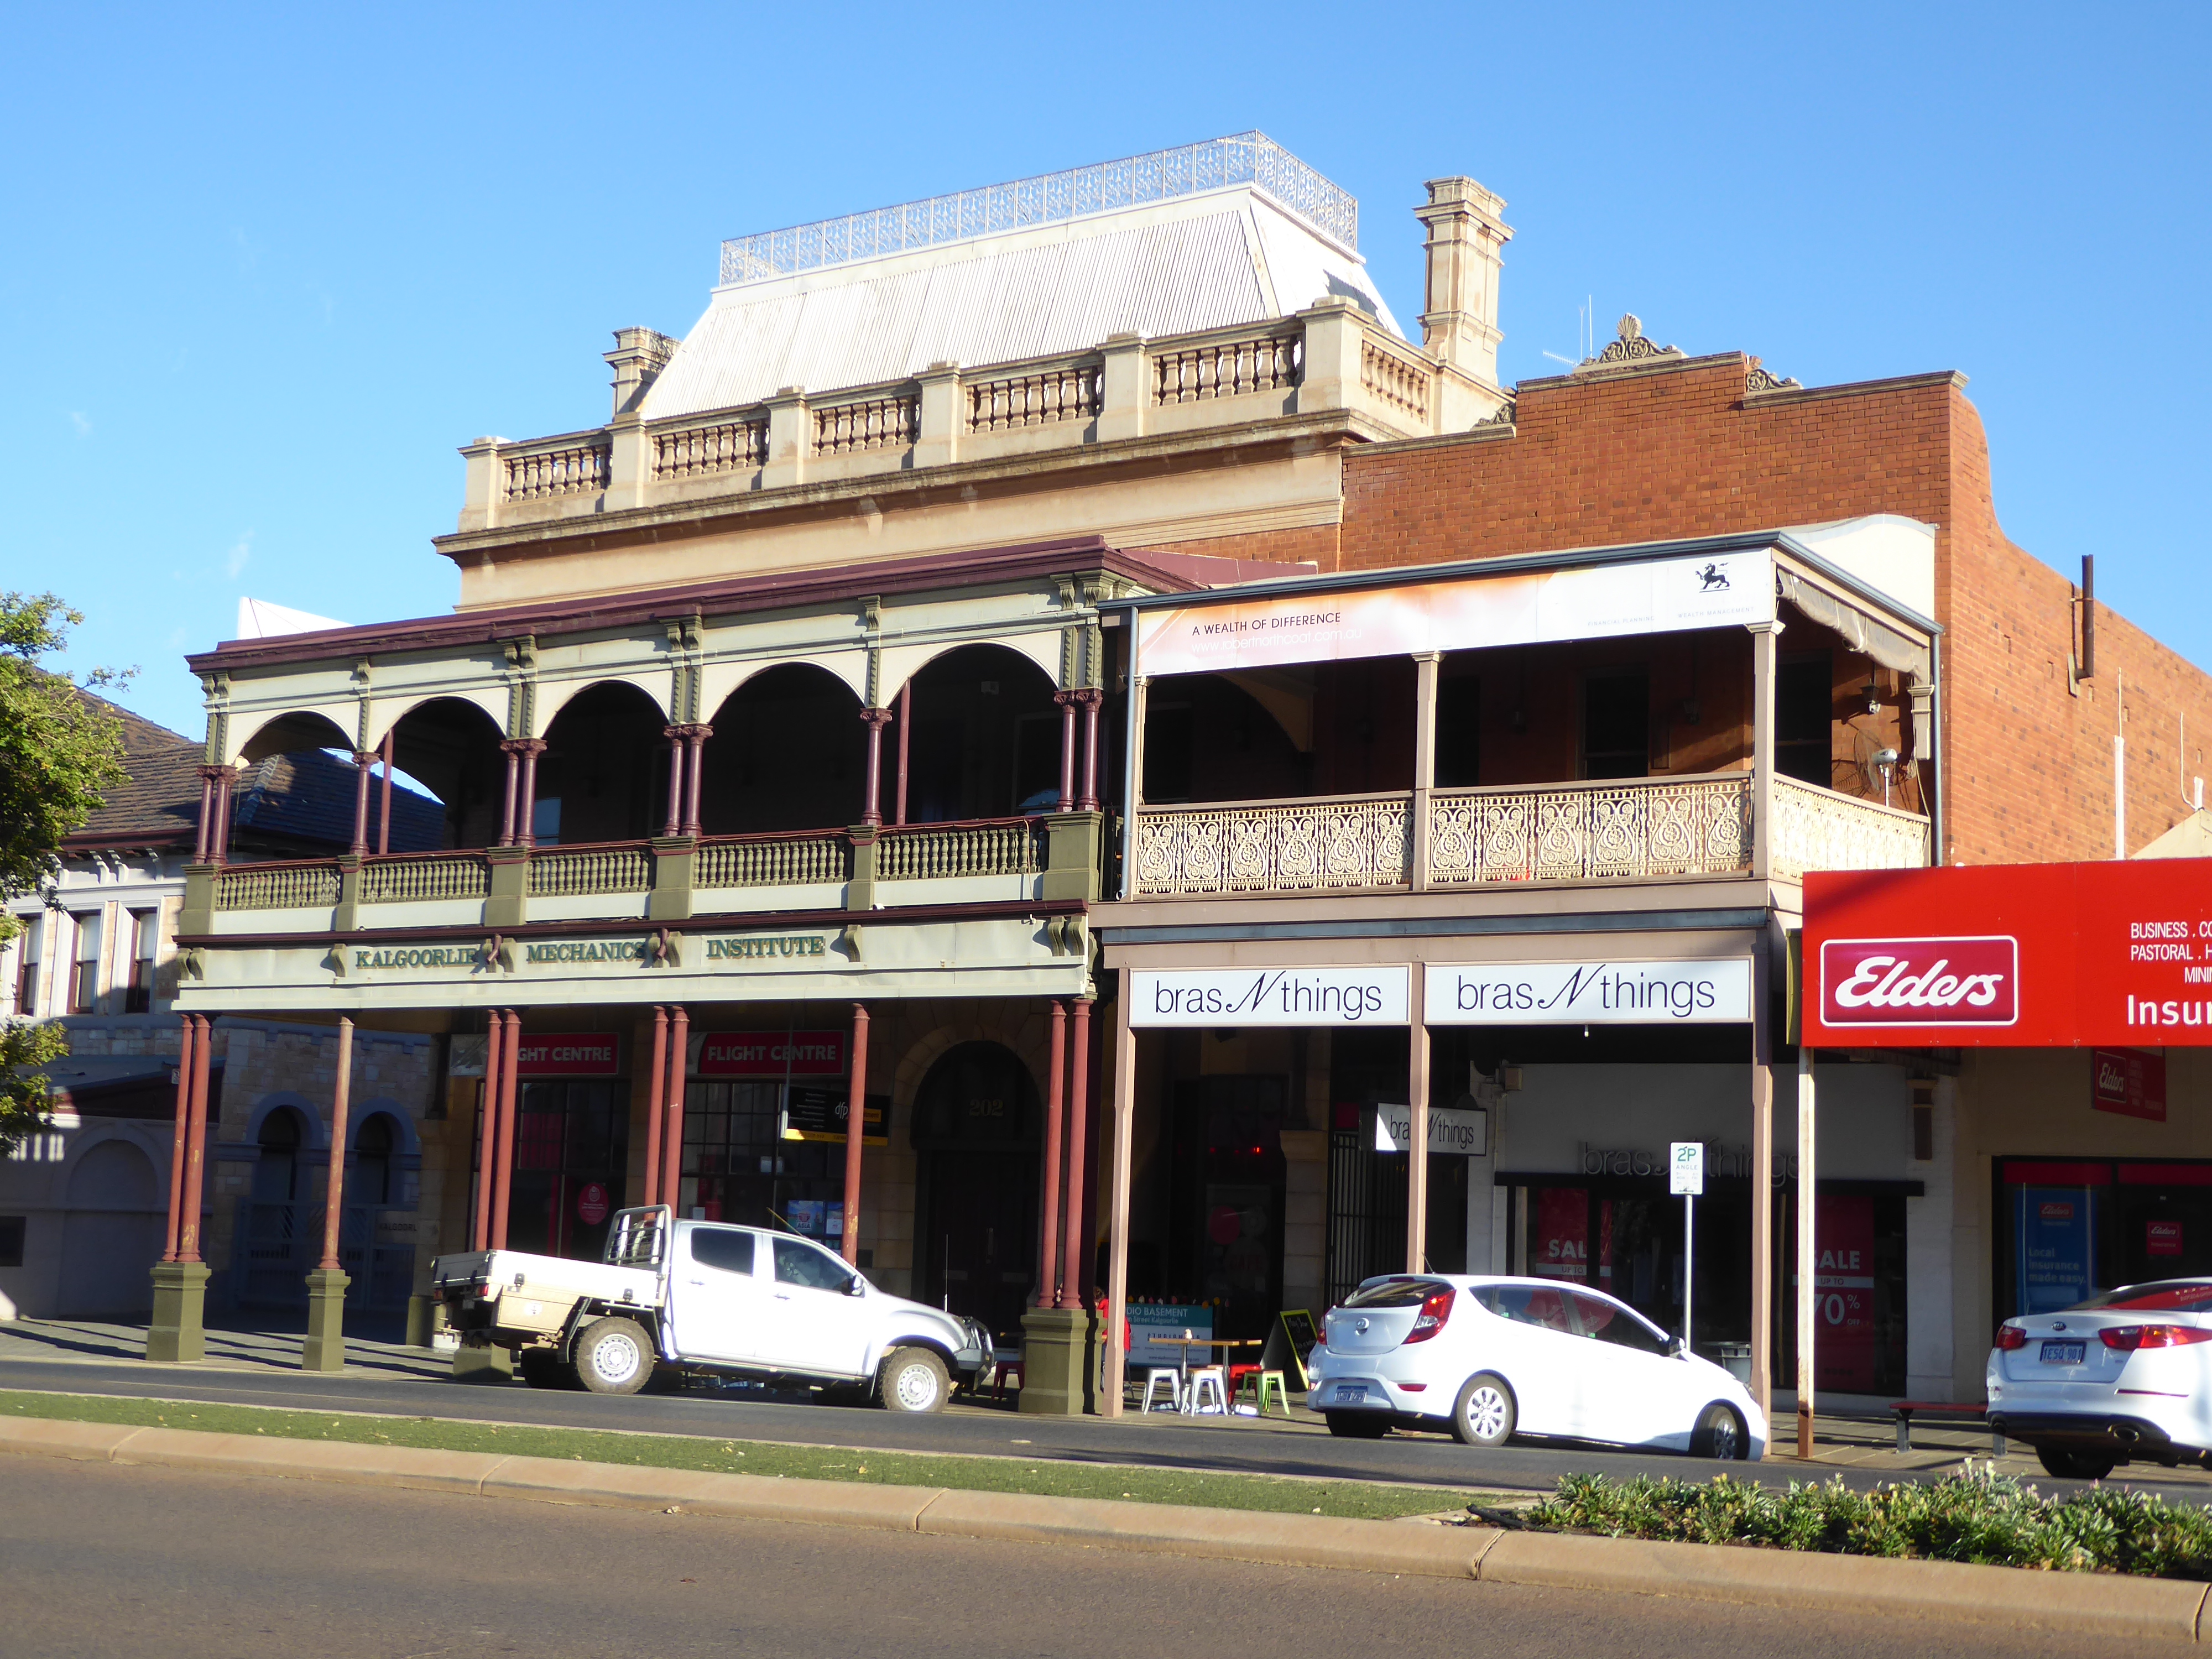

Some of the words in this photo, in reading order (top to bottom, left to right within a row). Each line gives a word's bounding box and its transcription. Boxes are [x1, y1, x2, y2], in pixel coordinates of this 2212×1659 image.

[1623, 615, 1655, 624] PLANNING
[1707, 606, 1755, 616] MANAGEMENT
[1192, 625, 1200, 636] A
[1203, 621, 1247, 635] WEALTH
[1251, 619, 1267, 630] OF
[1271, 612, 1341, 629] DIFFERENCE
[1191, 628, 1362, 653] www.robertnorthcoat.com.au
[2131, 921, 2188, 938] BUSINESS
[526, 941, 646, 963] MECHANICS
[706, 936, 826, 959] INSTITUTE
[2131, 943, 2194, 961] PASTORAL
[356, 947, 478, 968] KALGOORLIE
[1835, 956, 2004, 1007] Elders
[2184, 966, 2212, 983] MINI
[1156, 980, 1222, 1013] bras
[1225, 971, 1286, 1013] N
[1281, 978, 1381, 1020] things
[1458, 975, 1533, 1010] bras
[1537, 964, 1606, 1009] N
[1600, 972, 1715, 1018] things
[518, 1047, 549, 1062] GHT
[551, 1046, 612, 1062] CENTRE
[708, 1045, 766, 1061] FLIGHT
[770, 1045, 836, 1061] CENTRE
[2099, 1062, 2125, 1093] Elders
[969, 1098, 1004, 1117] 202
[1390, 1115, 1410, 1140] bra
[1438, 1118, 1474, 1149] things
[1677, 1147, 1697, 1162] 2P
[1583, 1141, 1651, 1176] bras
[1707, 1144, 1799, 1187] thigs
[2041, 1204, 2069, 1215] Elders
[2151, 1225, 2176, 1235] Elders
[1548, 1238, 1587, 1259] SAL
[2028, 1247, 2055, 1258] Local
[2028, 1260, 2080, 1271] insurance
[2028, 1273, 2057, 1283] made
[1144, 1307, 1188, 1317] BASEMENT
[2067, 1348, 2081, 1360] 901
